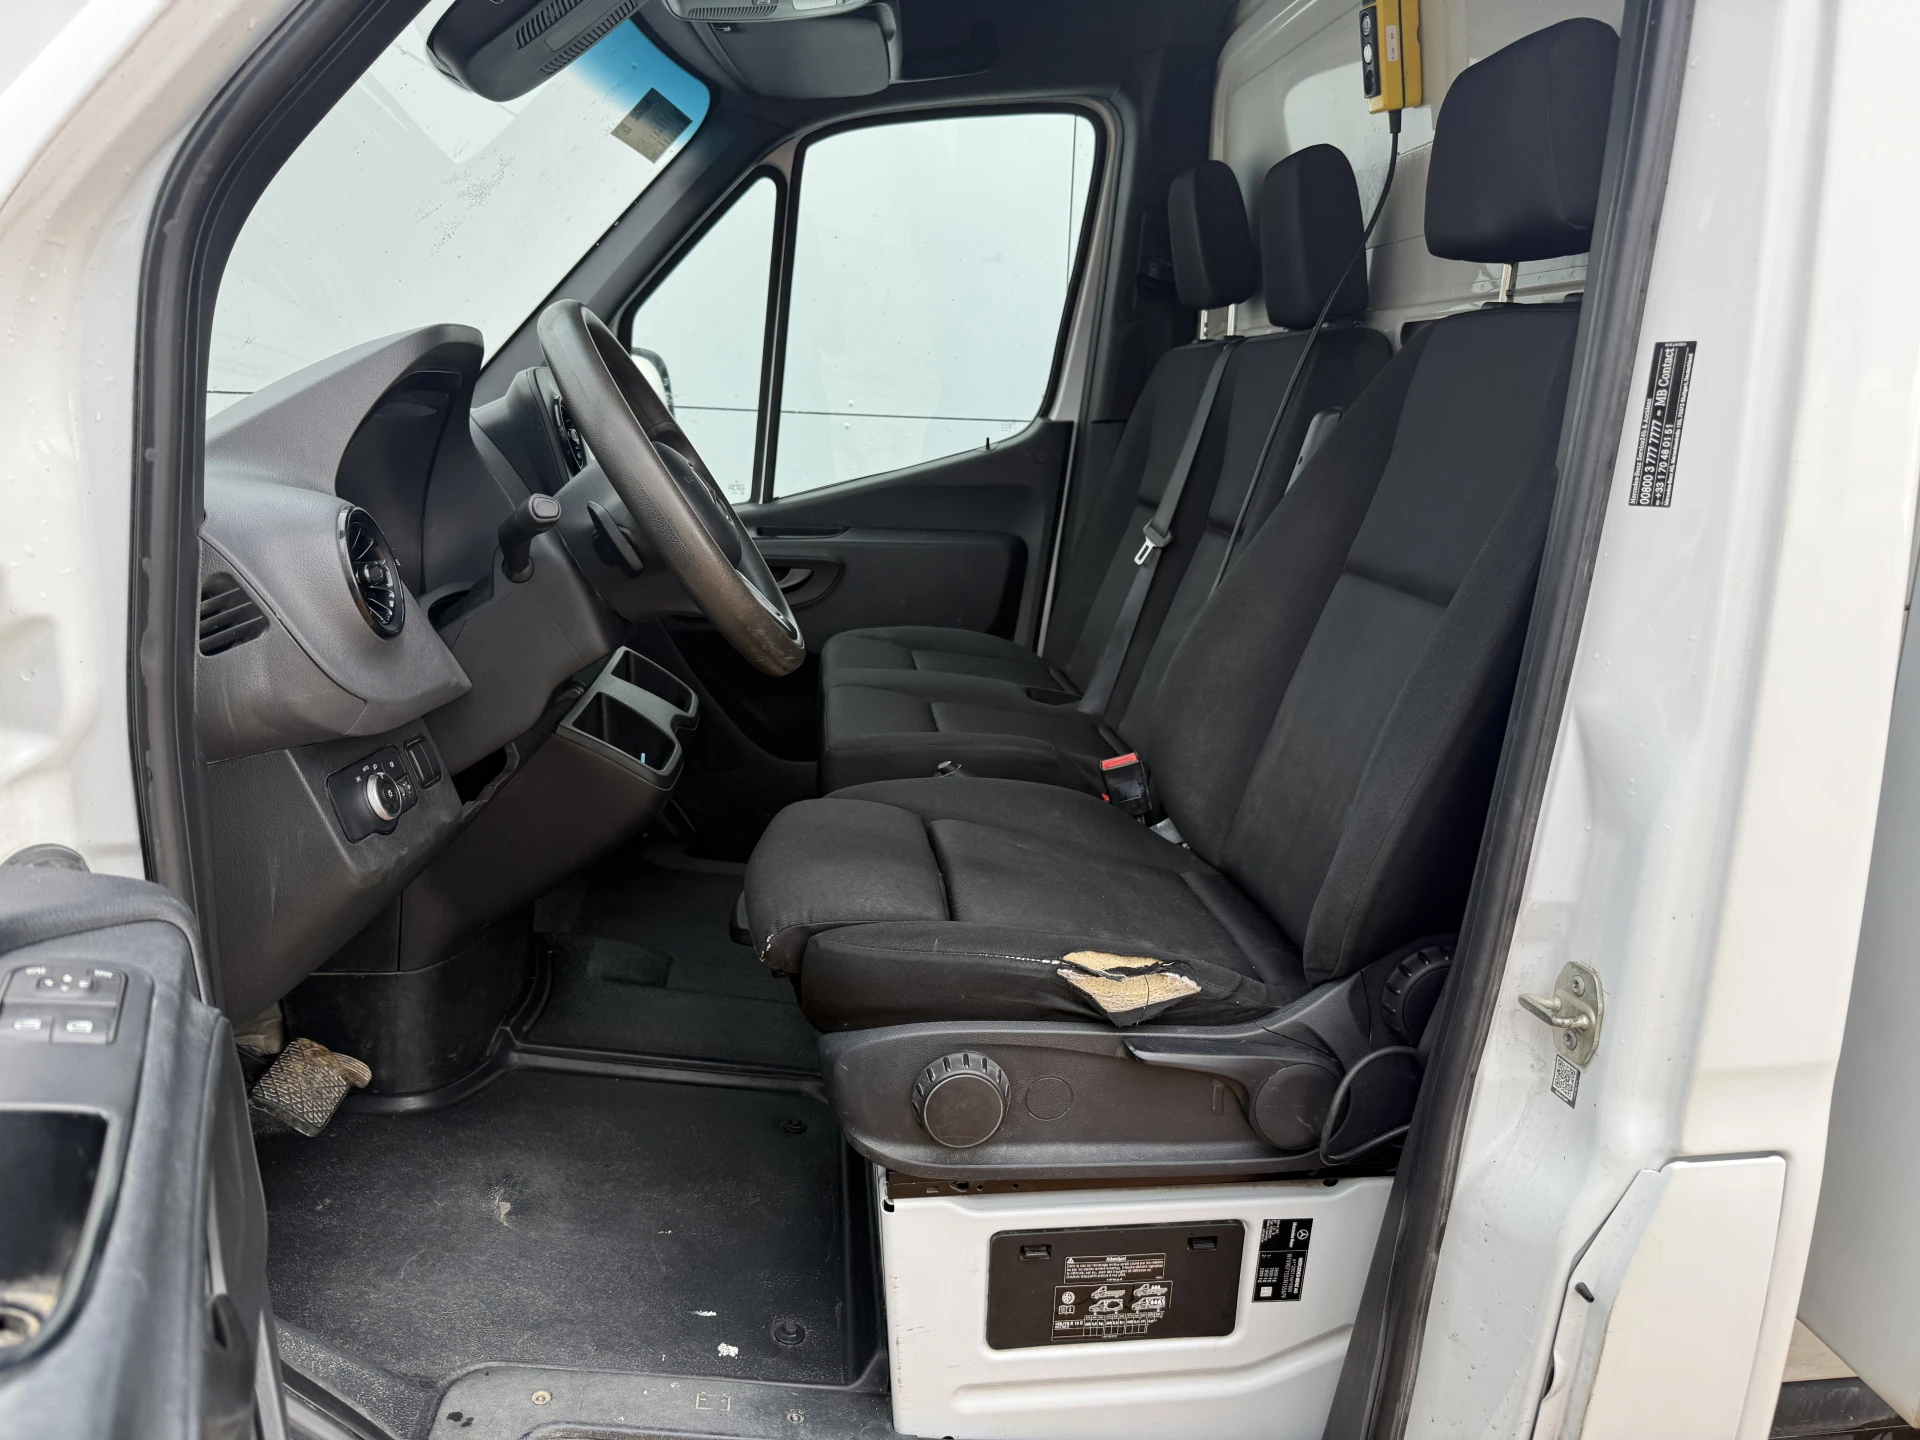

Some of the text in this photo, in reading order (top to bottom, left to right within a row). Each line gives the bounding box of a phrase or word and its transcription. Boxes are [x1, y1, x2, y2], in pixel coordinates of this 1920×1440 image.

[1658, 347, 1675, 387] Contact
[1655, 389, 1668, 407] MB
[1649, 419, 1662, 444] 7777
[1630, 462, 1642, 504] Mercedes-Benz
[1643, 398, 1653, 423] Accident
[1662, 437, 1672, 447] 01
[1646, 446, 1658, 464] 777
[1660, 449, 1670, 460] 48
[1658, 462, 1668, 472] 70
[1639, 475, 1654, 505] 00800
[1655, 482, 1664, 498] +33
